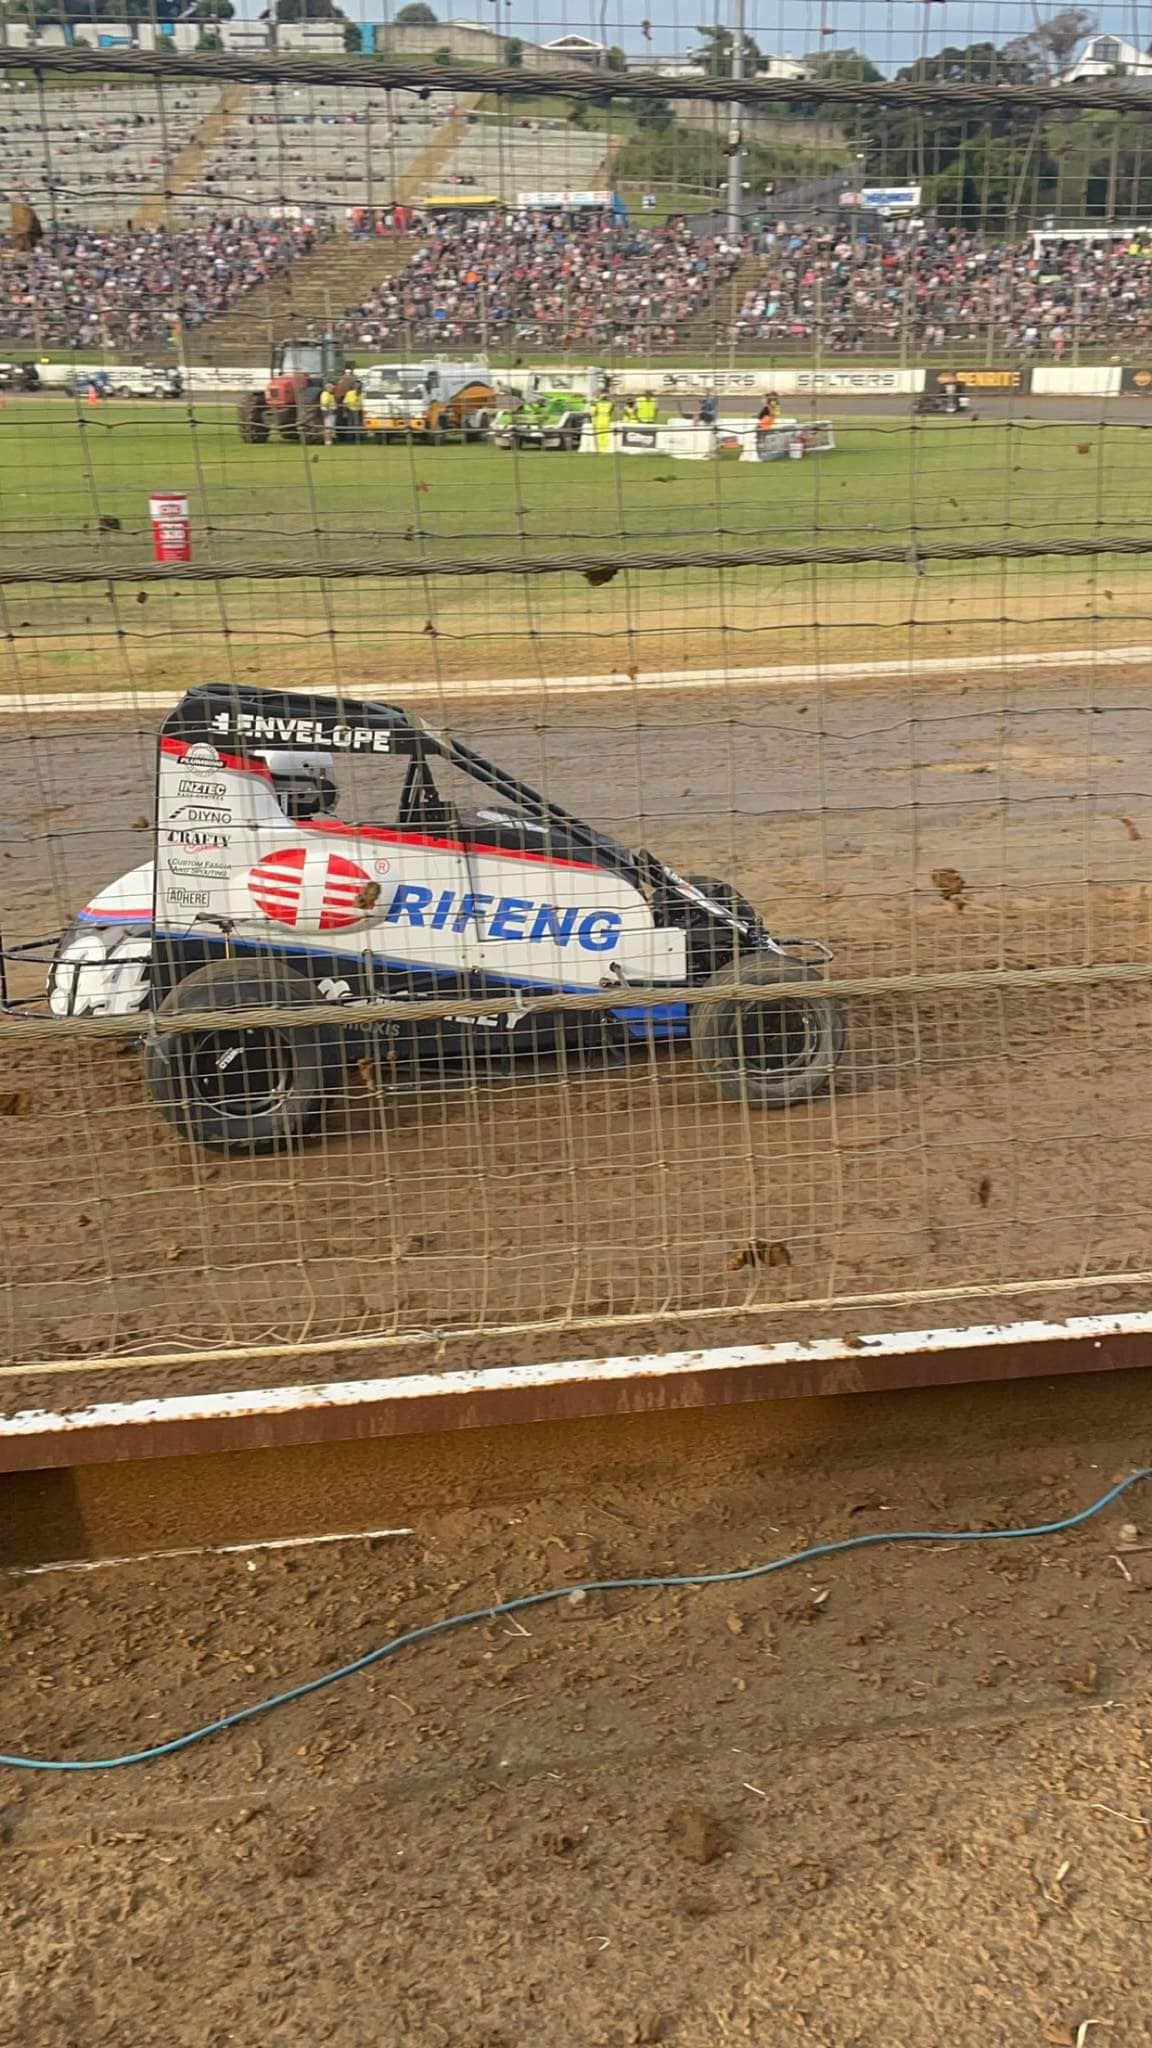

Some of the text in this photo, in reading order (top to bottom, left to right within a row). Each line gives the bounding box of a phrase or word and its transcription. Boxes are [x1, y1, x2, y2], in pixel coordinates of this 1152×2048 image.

[798, 373, 895, 387] SALTERS
[237, 713, 391, 752] ENVELOPE
[180, 780, 226, 797] INZTEC
[188, 809, 232, 824] DIYNO
[169, 890, 207, 905] ADHERE
[384, 884, 622, 952] RIFENG
